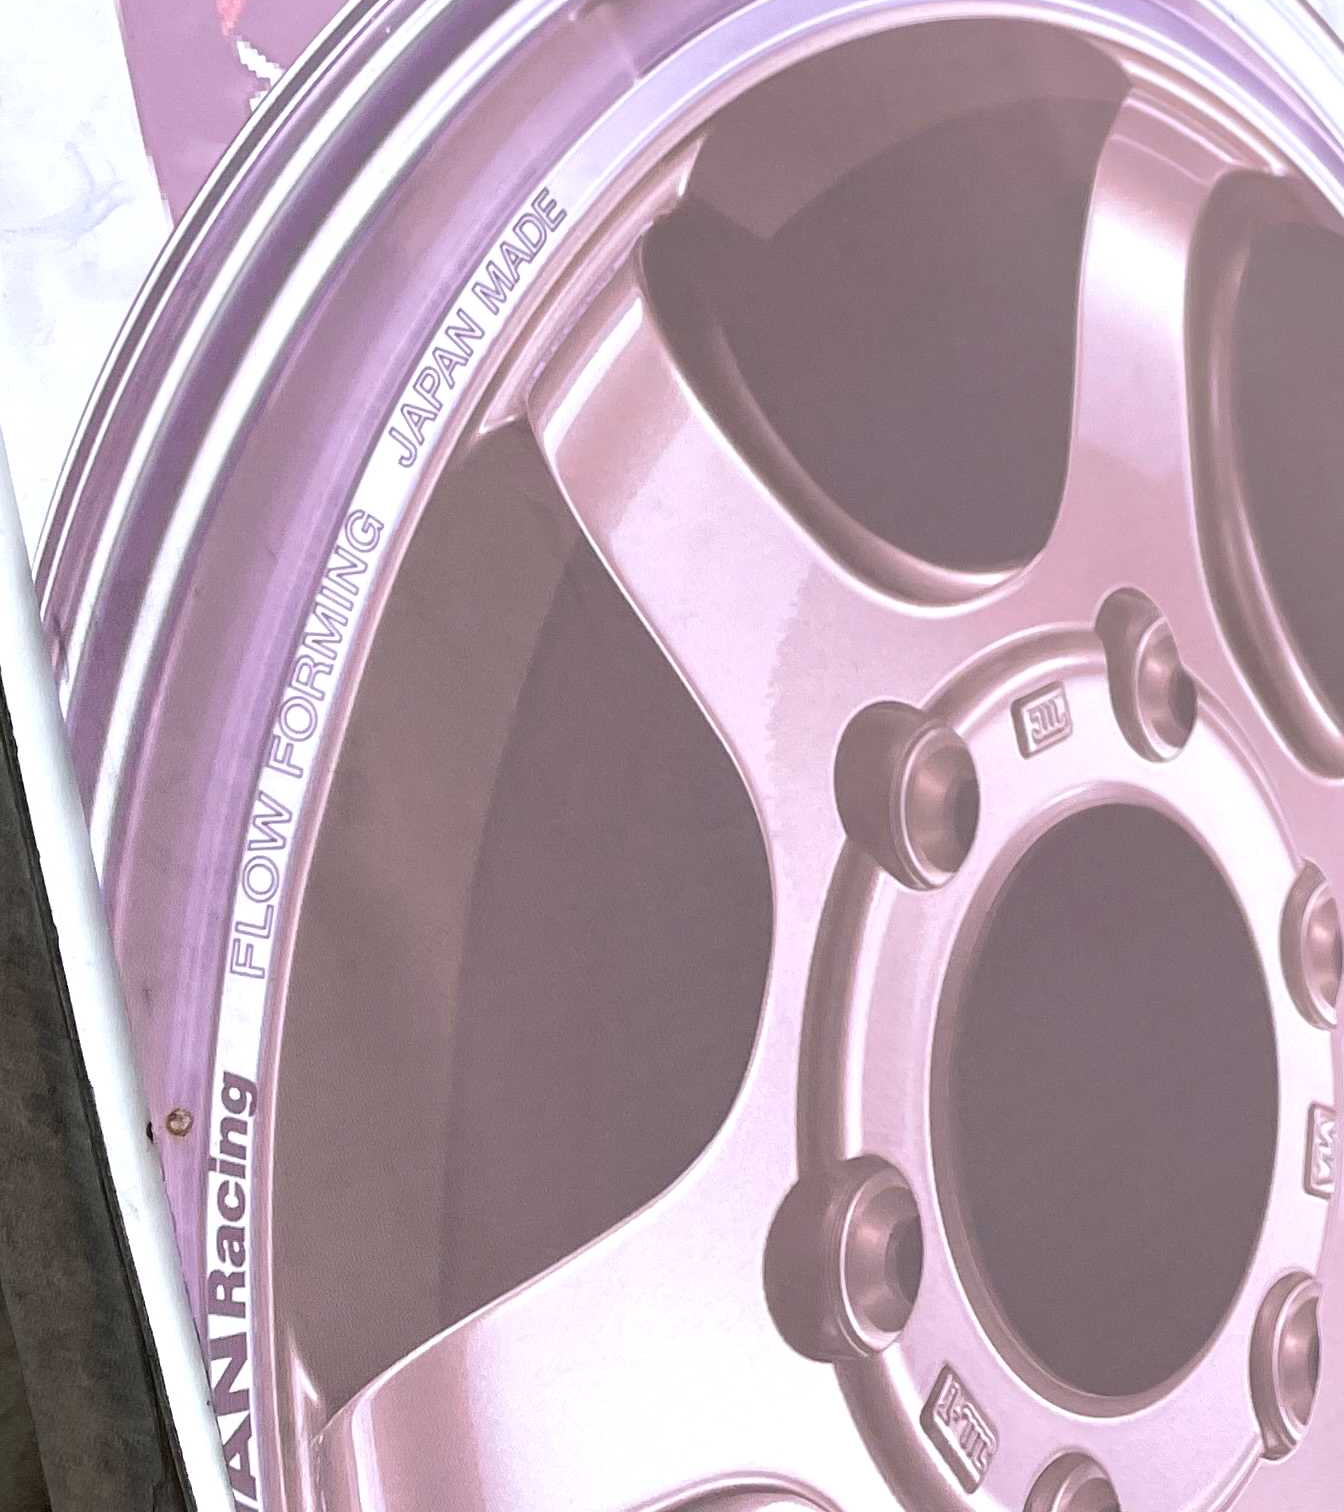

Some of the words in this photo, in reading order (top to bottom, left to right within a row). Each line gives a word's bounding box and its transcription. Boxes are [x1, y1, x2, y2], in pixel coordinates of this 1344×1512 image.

[230, 789, 293, 979] FLOW
[268, 508, 385, 779] FORMING
[388, 307, 484, 468] JAPAN
[473, 186, 568, 311] MADE
[209, 1071, 258, 1321] Racing
